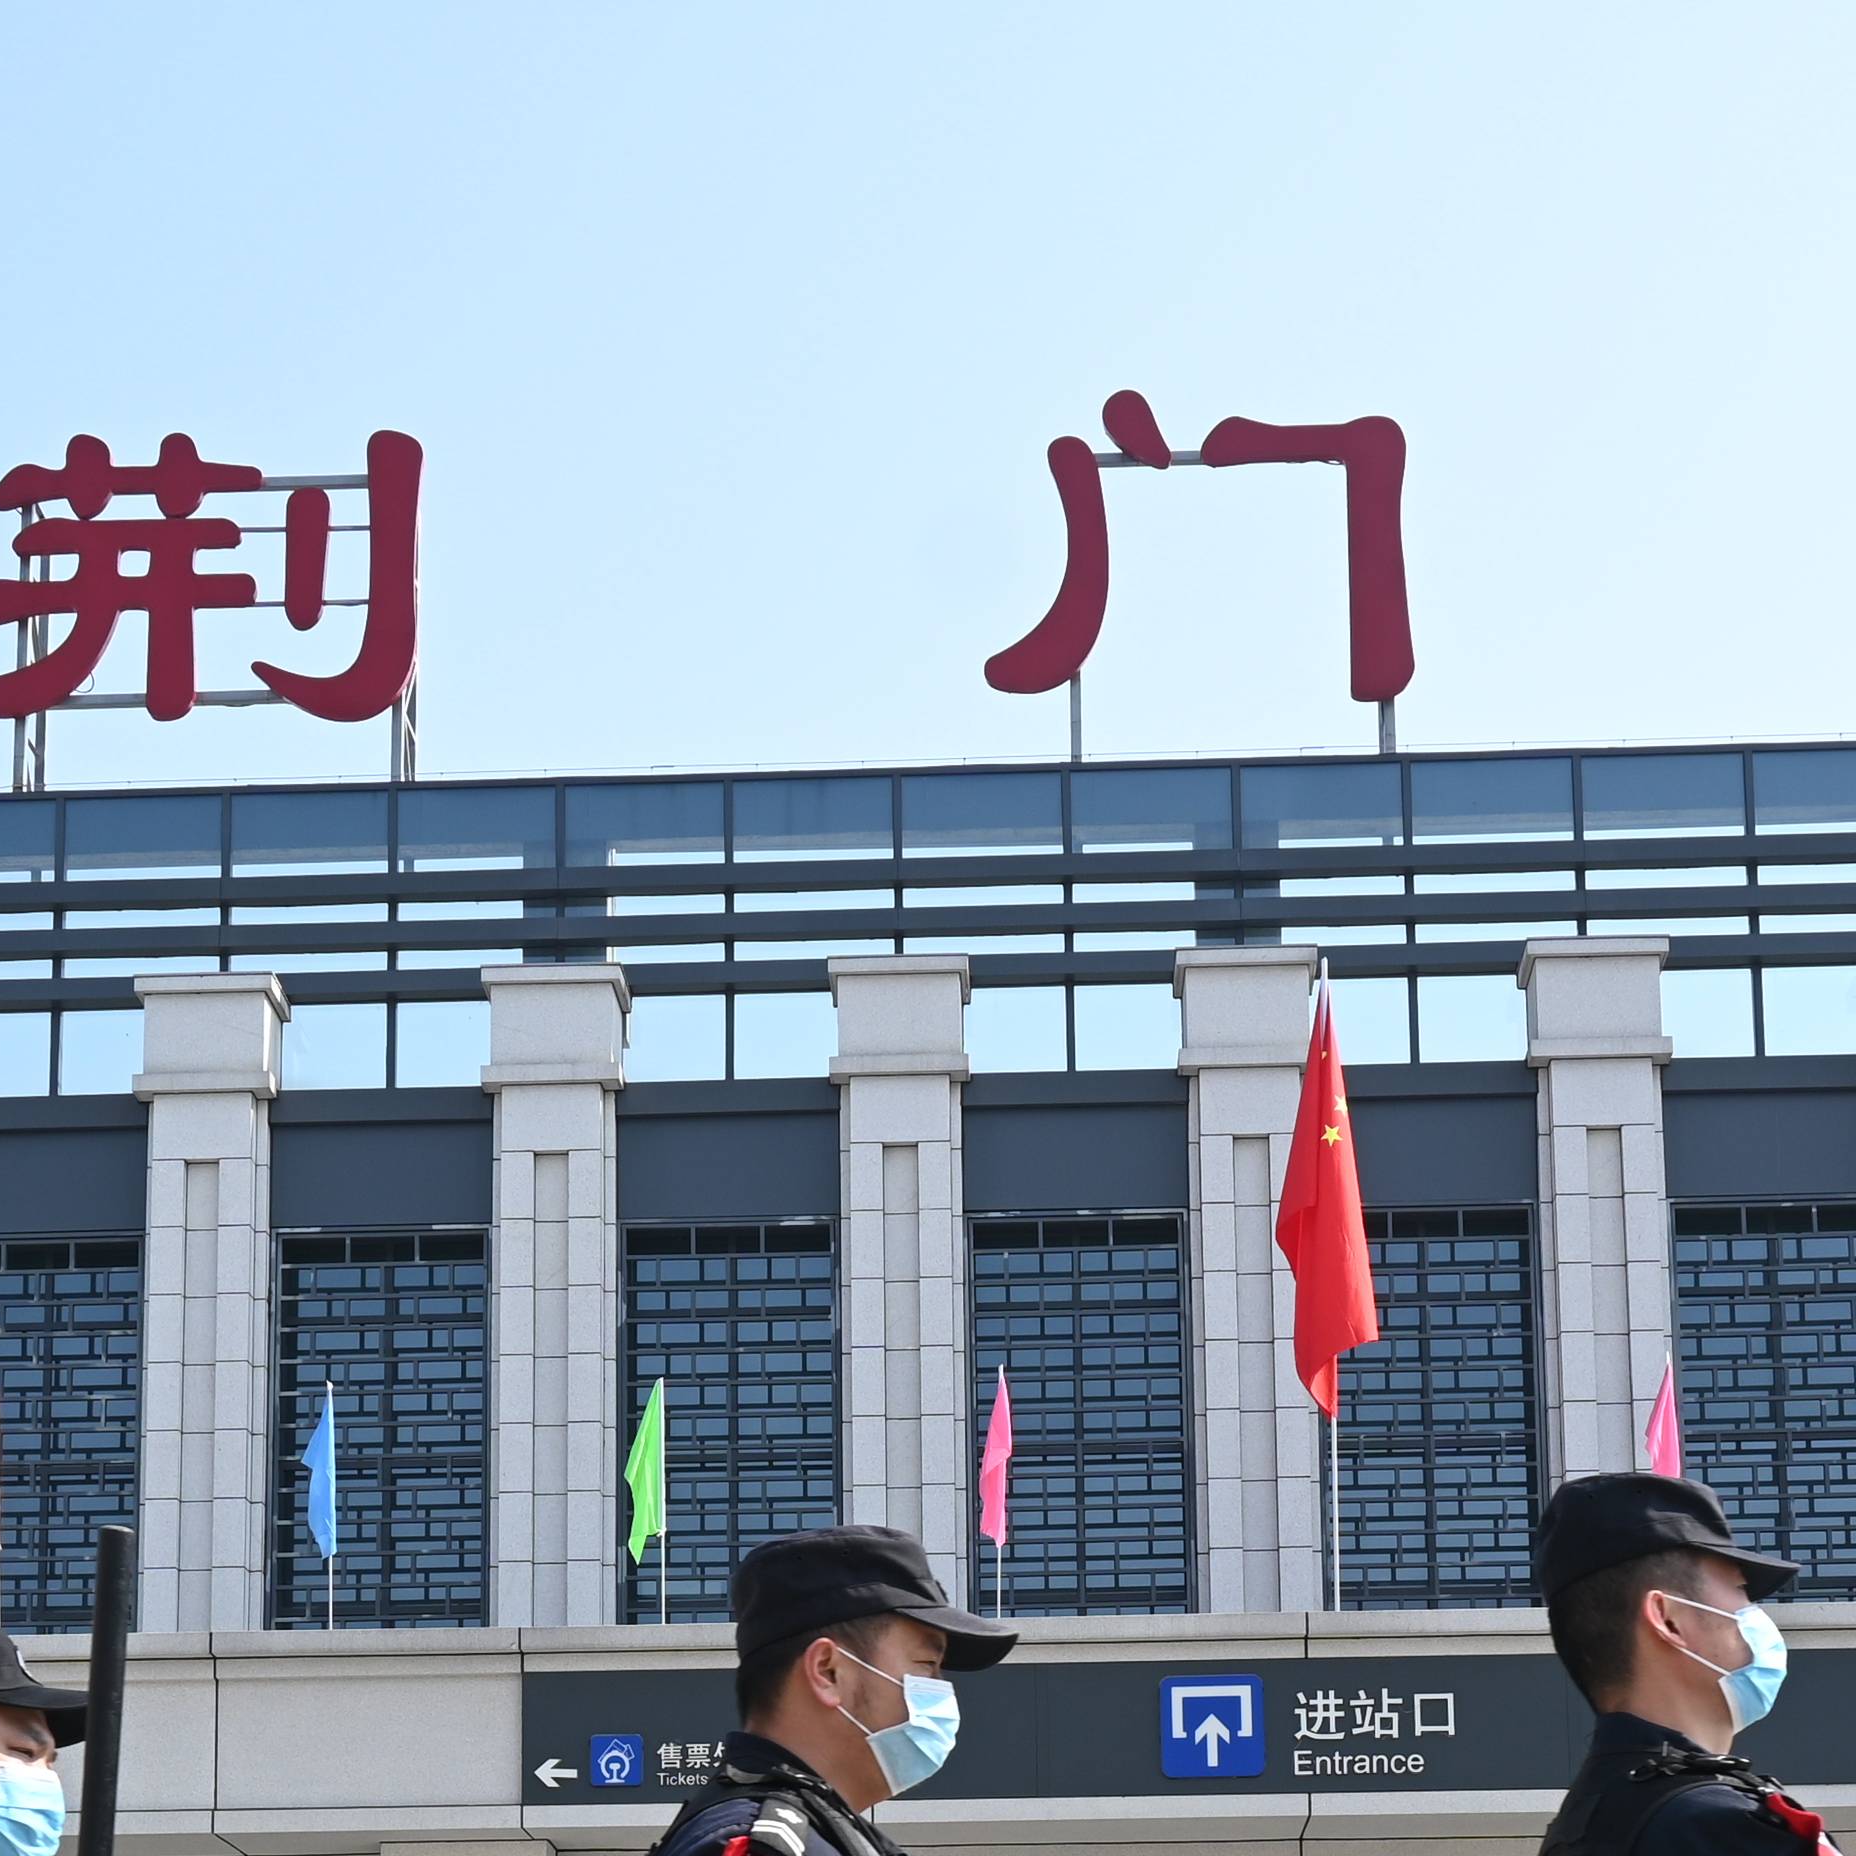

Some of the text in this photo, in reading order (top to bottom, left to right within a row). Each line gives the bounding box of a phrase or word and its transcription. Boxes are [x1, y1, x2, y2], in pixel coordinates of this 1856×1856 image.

[1294, 1687, 1456, 1740] 进站口
[1294, 1750, 1425, 1775] Entrance
[656, 1772, 709, 1786] Tickets
